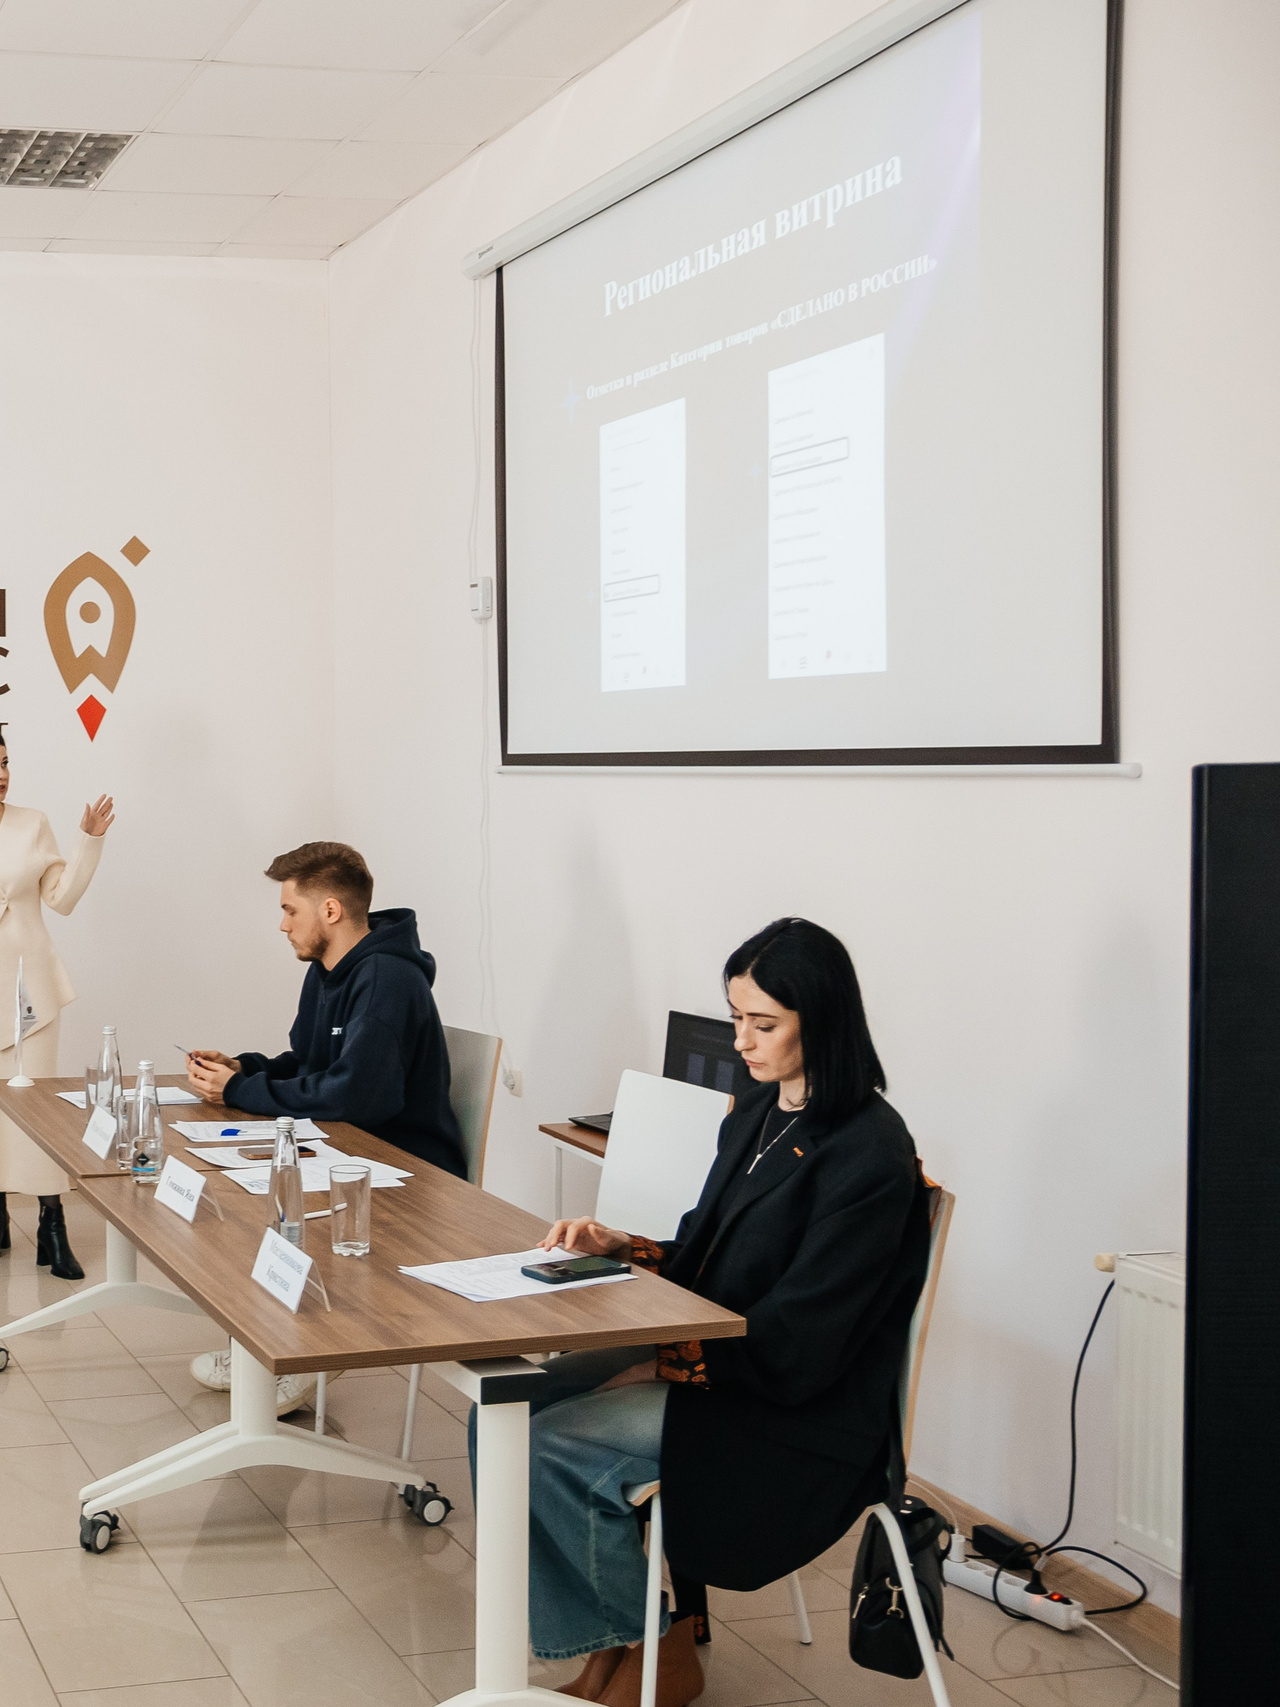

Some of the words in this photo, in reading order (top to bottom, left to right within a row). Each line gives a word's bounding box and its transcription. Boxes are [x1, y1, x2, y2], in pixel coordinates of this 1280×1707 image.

[603, 219, 767, 317] Региональная
[775, 154, 903, 239] витрина
[670, 339, 723, 369] Категории
[725, 321, 769, 348] товаров
[770, 287, 845, 330] «СДЕЛАНО
[847, 282, 858, 303] В
[860, 253, 938, 298] РОССИИ»
